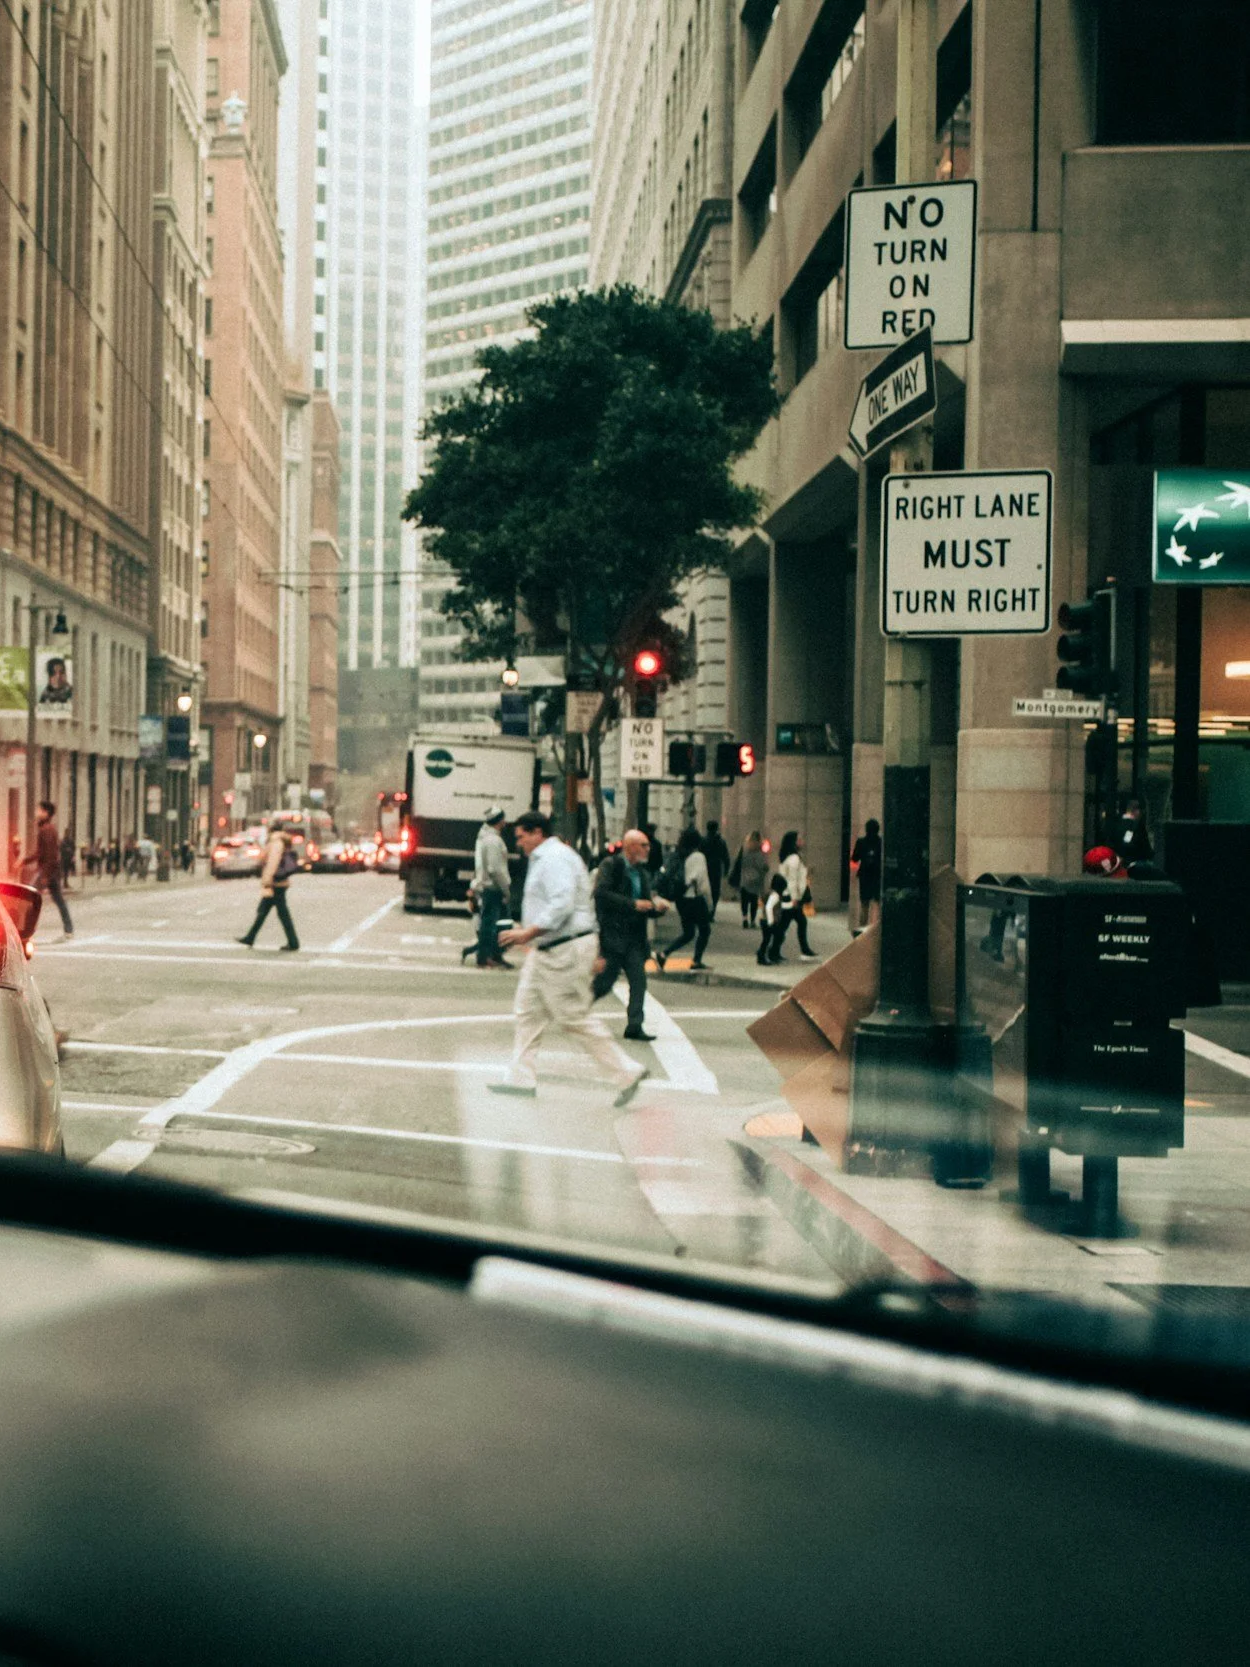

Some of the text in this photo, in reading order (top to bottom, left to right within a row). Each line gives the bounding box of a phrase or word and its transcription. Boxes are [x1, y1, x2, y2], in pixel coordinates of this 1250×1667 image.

[884, 197, 944, 230] NO
[874, 237, 947, 265] TURN
[889, 274, 929, 298] ON
[881, 308, 935, 335] RED
[868, 361, 919, 426] ONE WAY
[895, 492, 1040, 520] RIGHT LANE
[923, 538, 1011, 569] MUST
[892, 588, 1040, 614] TURN RIGHT
[1016, 701, 1099, 716] Montgomery
[632, 723, 654, 734] NO
[630, 738, 654, 748] TURN
[634, 751, 649, 761] ON
[1112, 934, 1150, 944] WEEKLY
